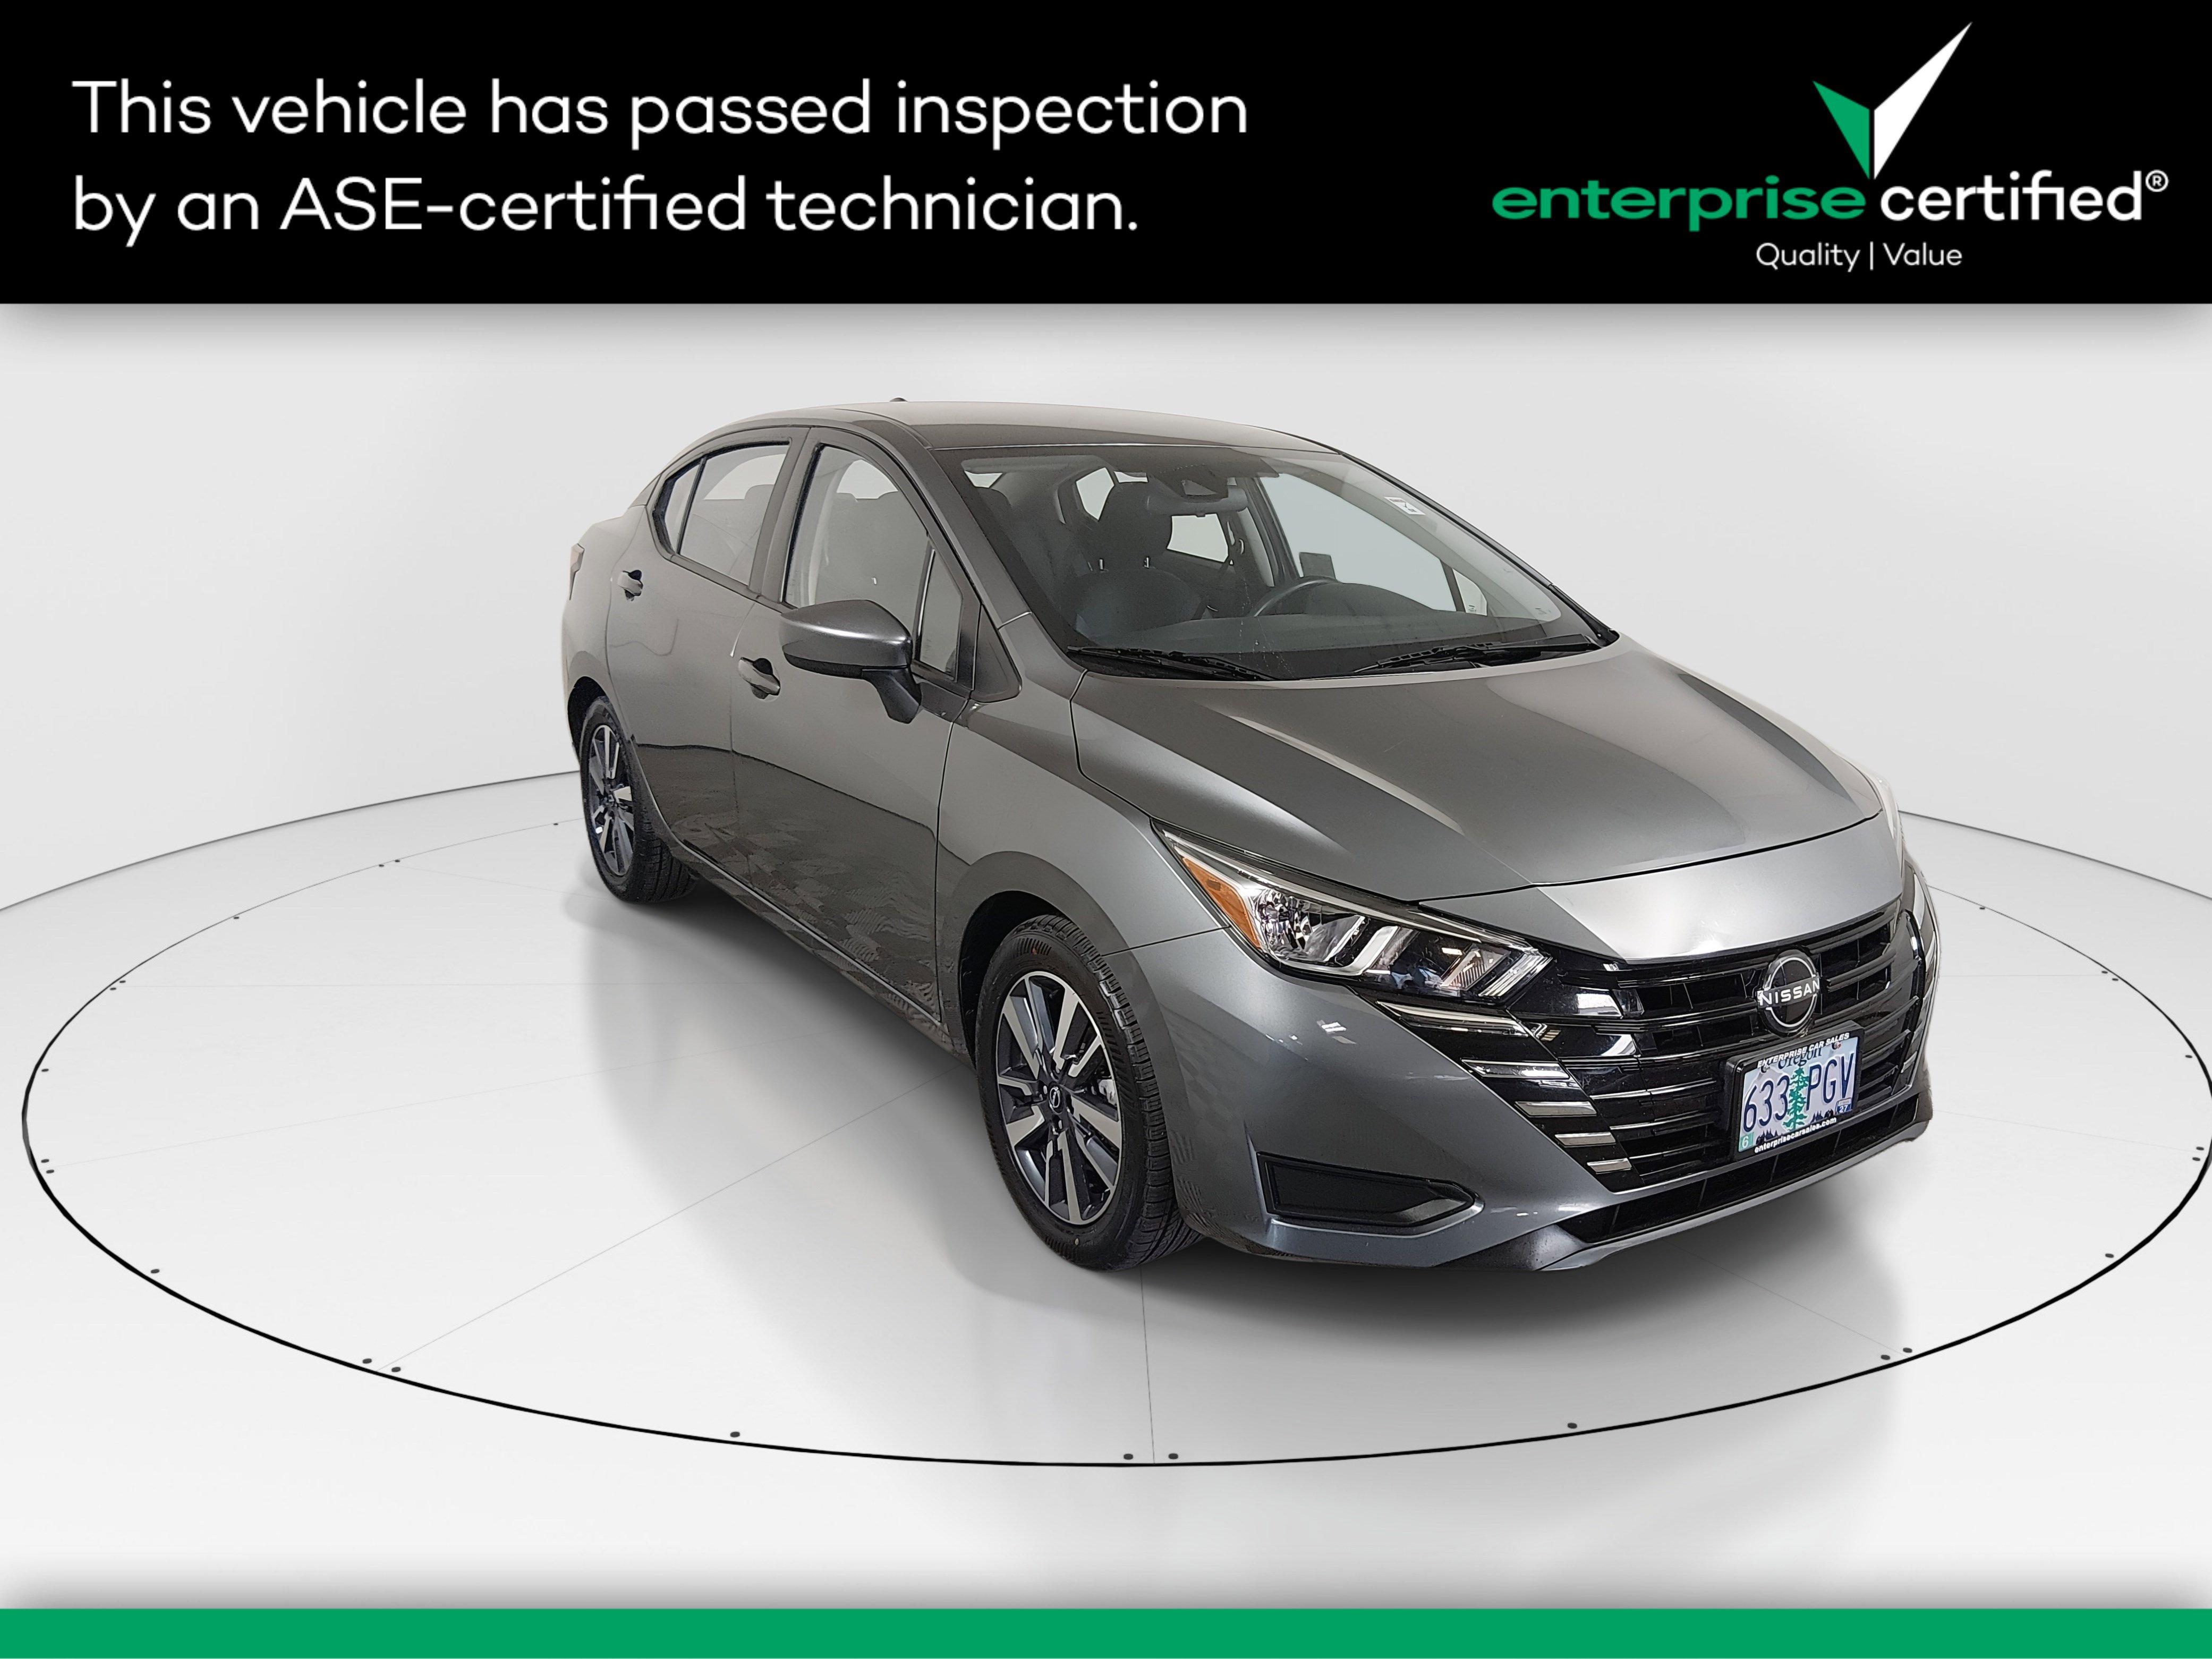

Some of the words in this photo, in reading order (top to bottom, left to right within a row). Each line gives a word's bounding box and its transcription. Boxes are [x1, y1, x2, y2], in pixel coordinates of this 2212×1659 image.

[1757, 978, 1819, 1006] NISSAN
[1757, 1047, 1807, 1068] ENTERPRISE
[1809, 1041, 1824, 1052] CAR
[1825, 1032, 1850, 1046] SALES
[1743, 1075, 1790, 1132] 633
[1806, 1052, 1854, 1110] PGV
[1839, 1104, 1848, 1113] 27
[1741, 1136, 1749, 1148] 6
[1755, 1117, 1836, 1153] enterprisecarsales.com
